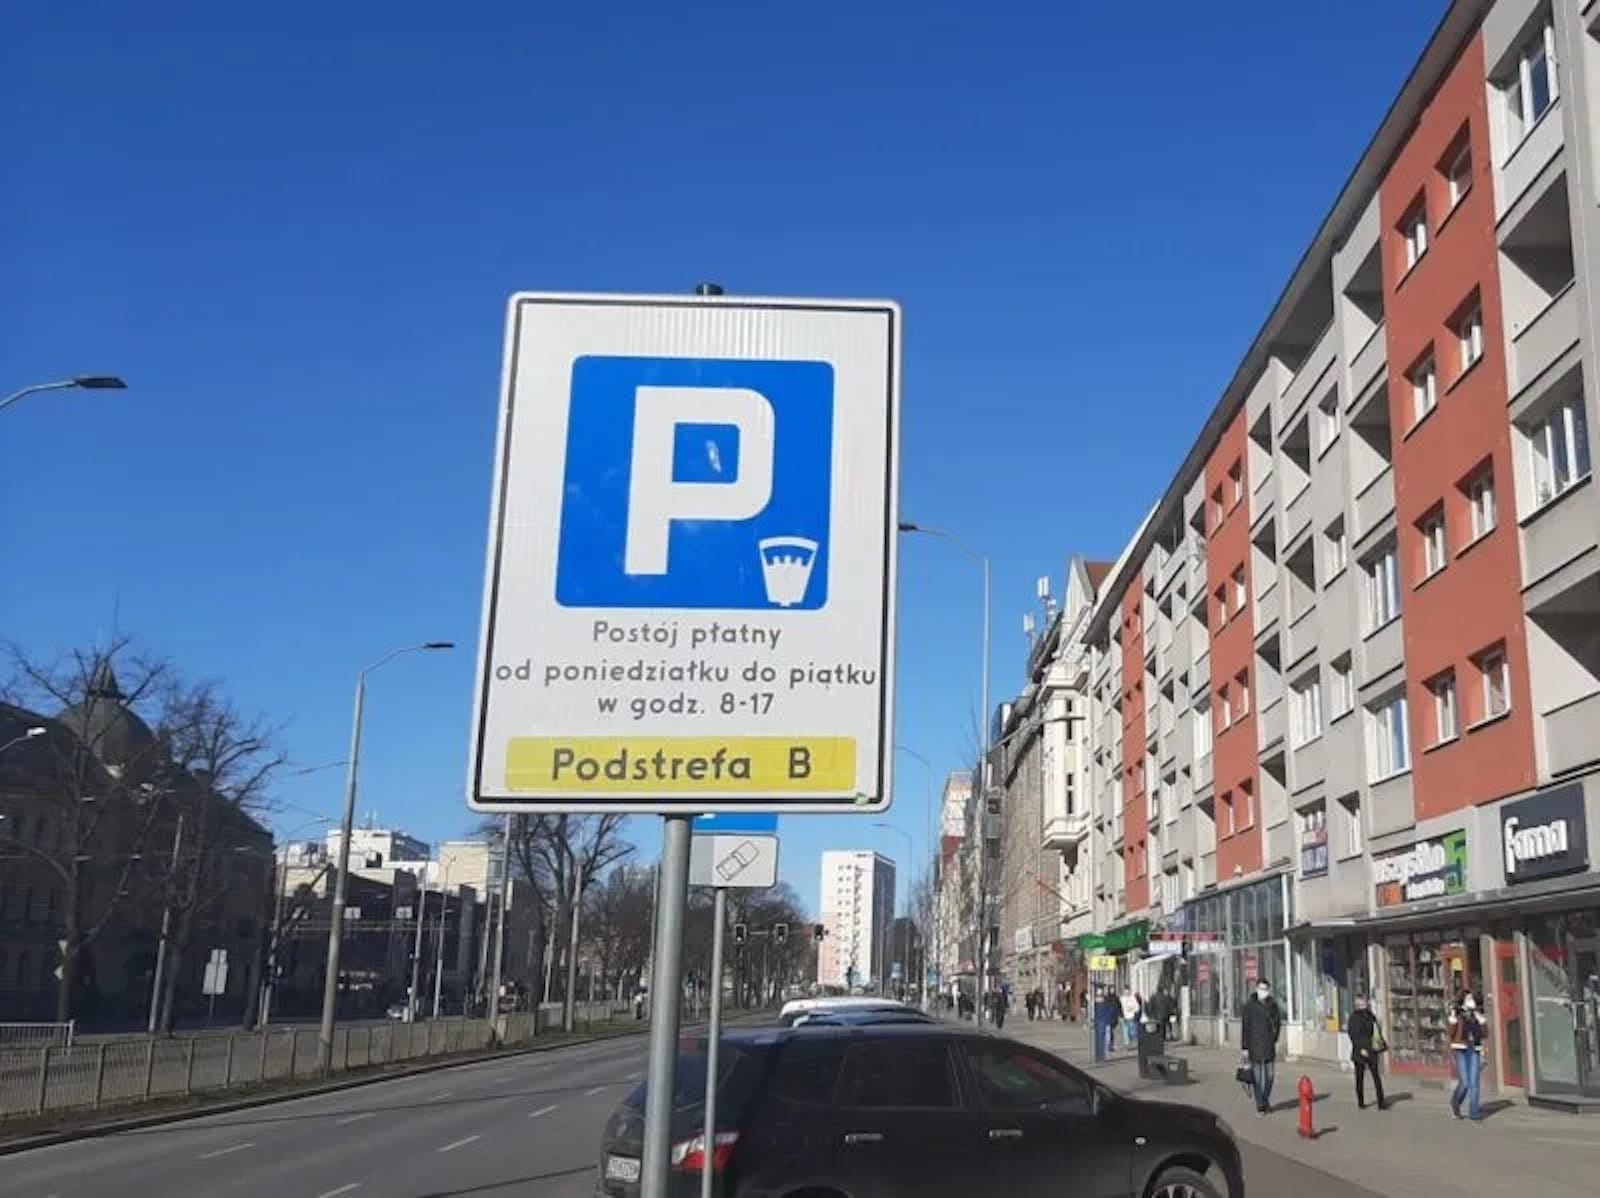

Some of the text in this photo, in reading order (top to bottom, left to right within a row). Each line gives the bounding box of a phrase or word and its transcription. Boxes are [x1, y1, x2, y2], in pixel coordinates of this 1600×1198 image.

[624, 384, 775, 576] P
[593, 619, 781, 650] Postój płatny
[495, 658, 876, 690] od poniedziałku do piątku
[597, 691, 775, 720] w godz. 8-17
[551, 747, 812, 782] Podstrefa B
[1505, 816, 1567, 874] fama
